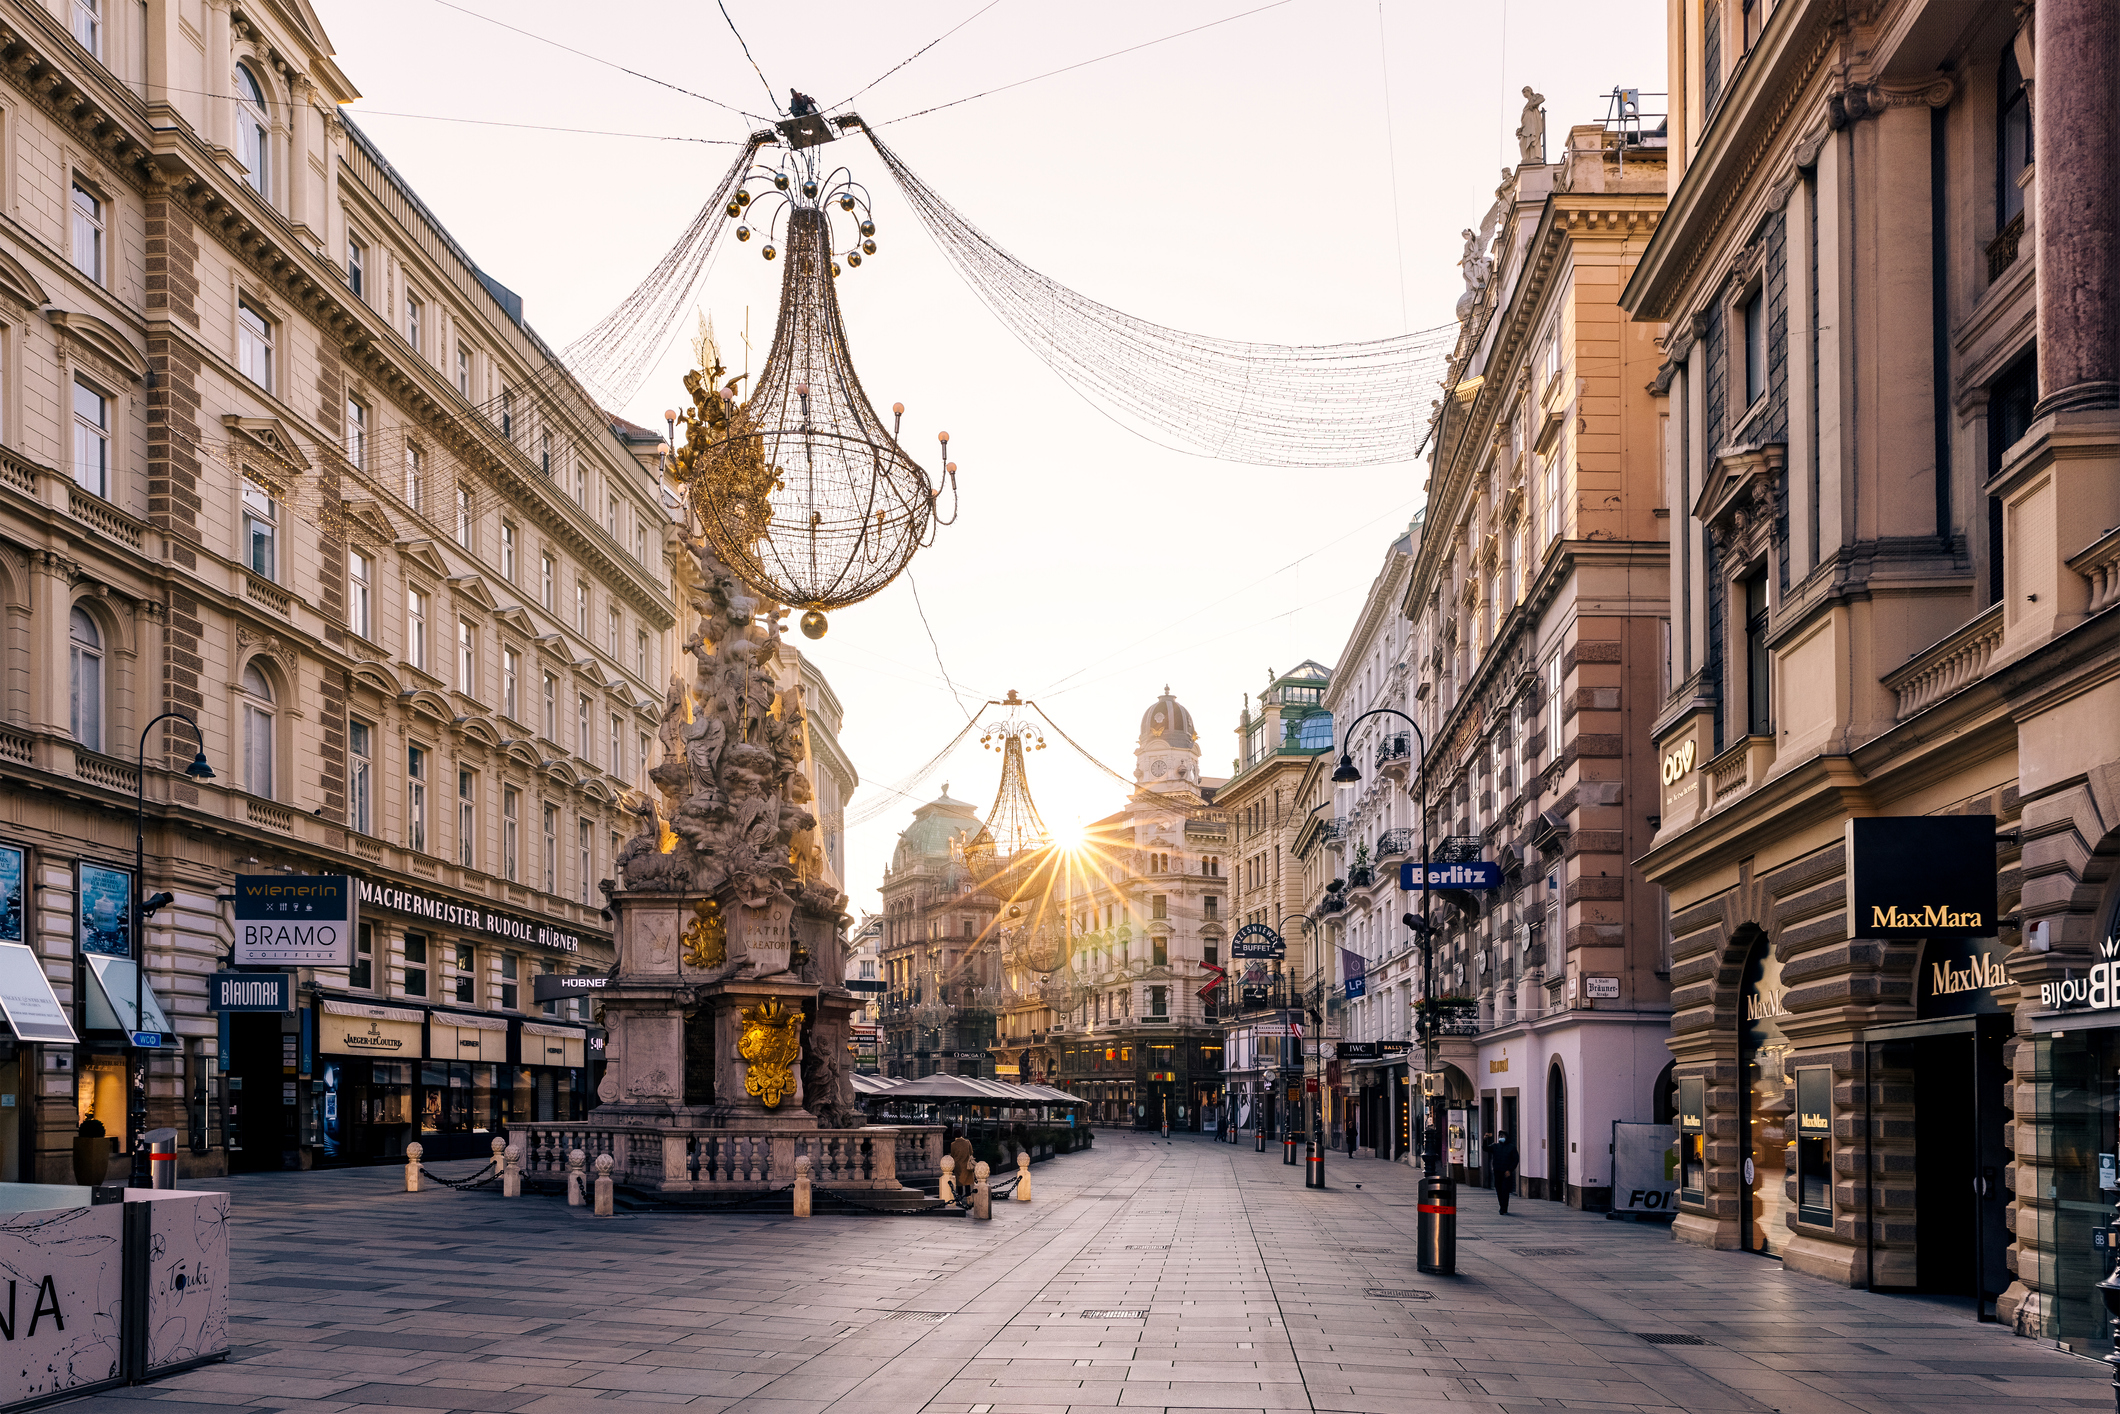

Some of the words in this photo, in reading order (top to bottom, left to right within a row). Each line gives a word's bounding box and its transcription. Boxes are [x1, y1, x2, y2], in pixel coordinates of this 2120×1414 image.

[1412, 865, 1486, 884] Berlitz
[246, 885, 337, 897] wienerin
[358, 880, 483, 930] MACHERMEISTER
[538, 926, 578, 952] HÜBNER
[750, 909, 783, 921] DEO
[1871, 905, 1982, 928] MaxMara
[245, 925, 337, 946] BRAMO
[747, 925, 785, 936] PATRI
[1233, 925, 1279, 949] TRZESNIEWS
[1242, 944, 1271, 952] BUFFET
[1931, 952, 2018, 996] MaxMar
[2041, 978, 2088, 1009] BIJOU
[1349, 1045, 1367, 1053] IWC
[1683, 1114, 1701, 1127] MaxMara
[1801, 1113, 1828, 1128] MaxMara
